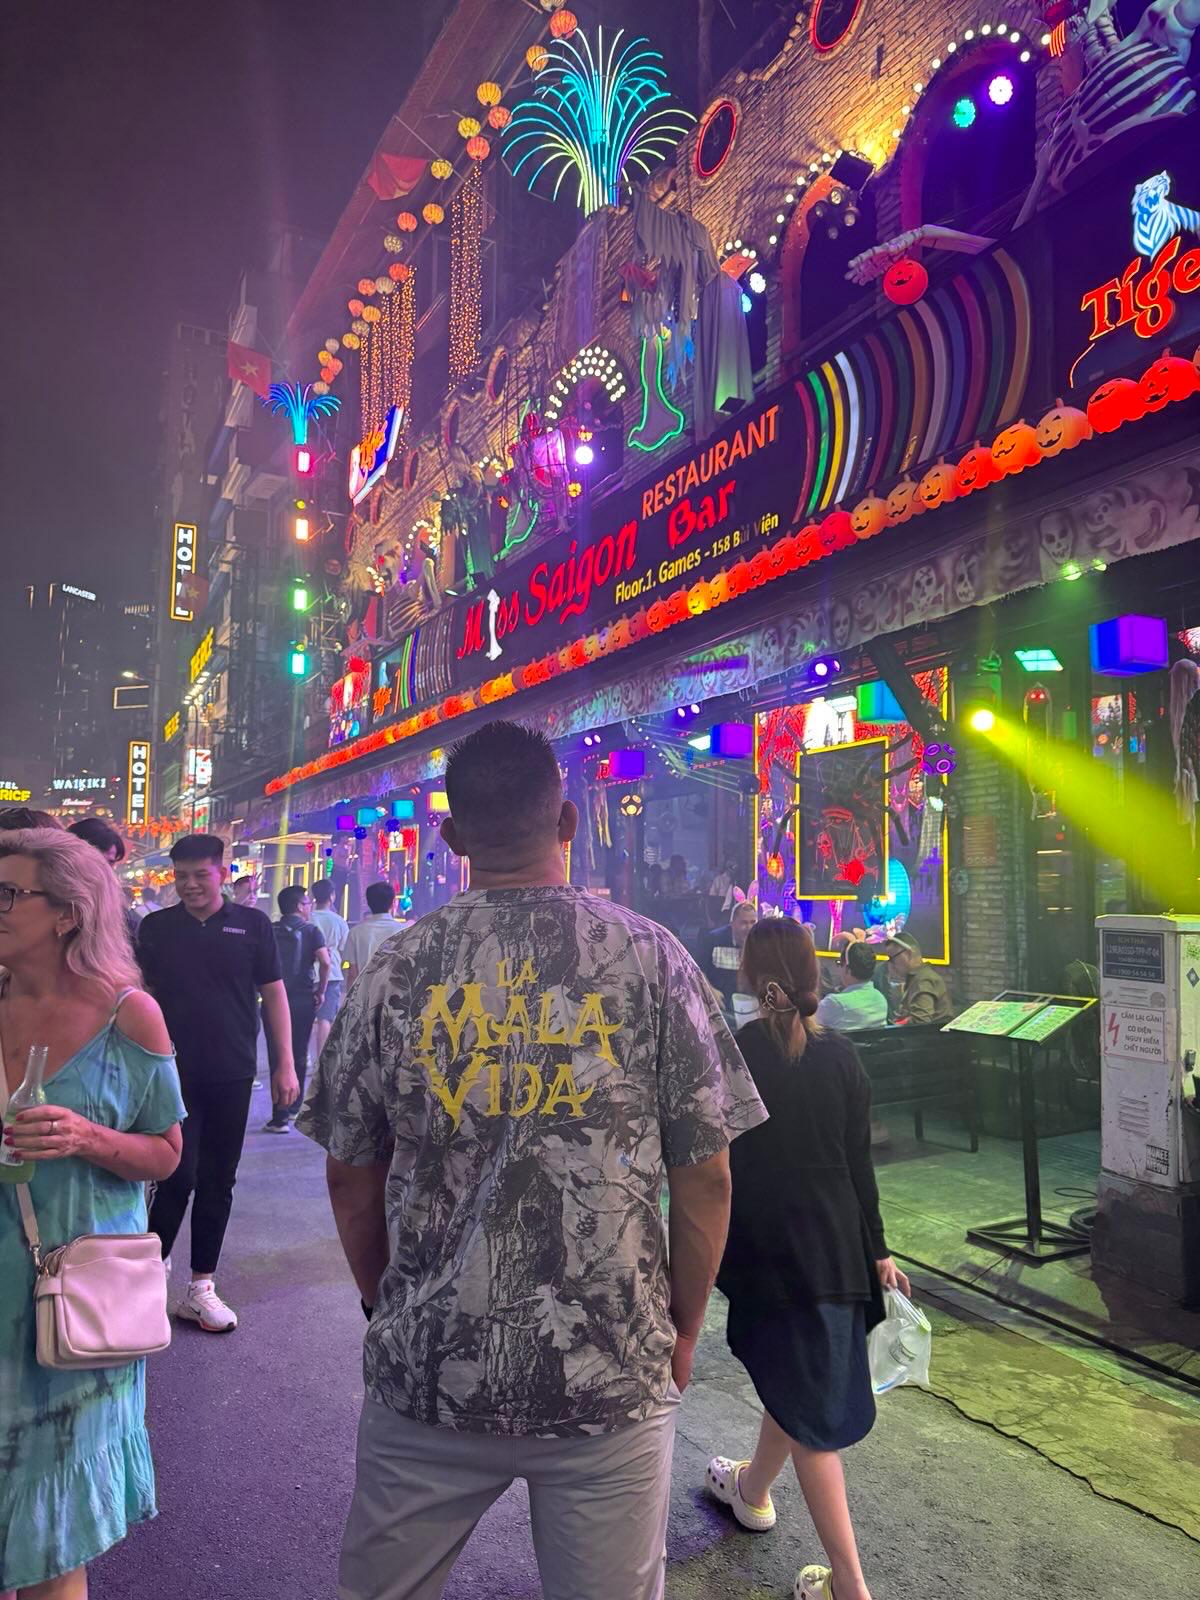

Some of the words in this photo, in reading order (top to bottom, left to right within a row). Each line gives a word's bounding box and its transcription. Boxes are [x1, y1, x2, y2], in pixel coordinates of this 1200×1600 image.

[642, 405, 779, 520] RESTAURANT
[668, 480, 736, 550] Bar
[525, 520, 637, 625] Saigon
[659, 548, 701, 585] Games
[711, 535, 731, 558] 158
[53, 778, 106, 790] WAIKIKI
[496, 956, 539, 990] LA
[412, 982, 625, 1068] MALA
[410, 1052, 596, 1137] VIDA
